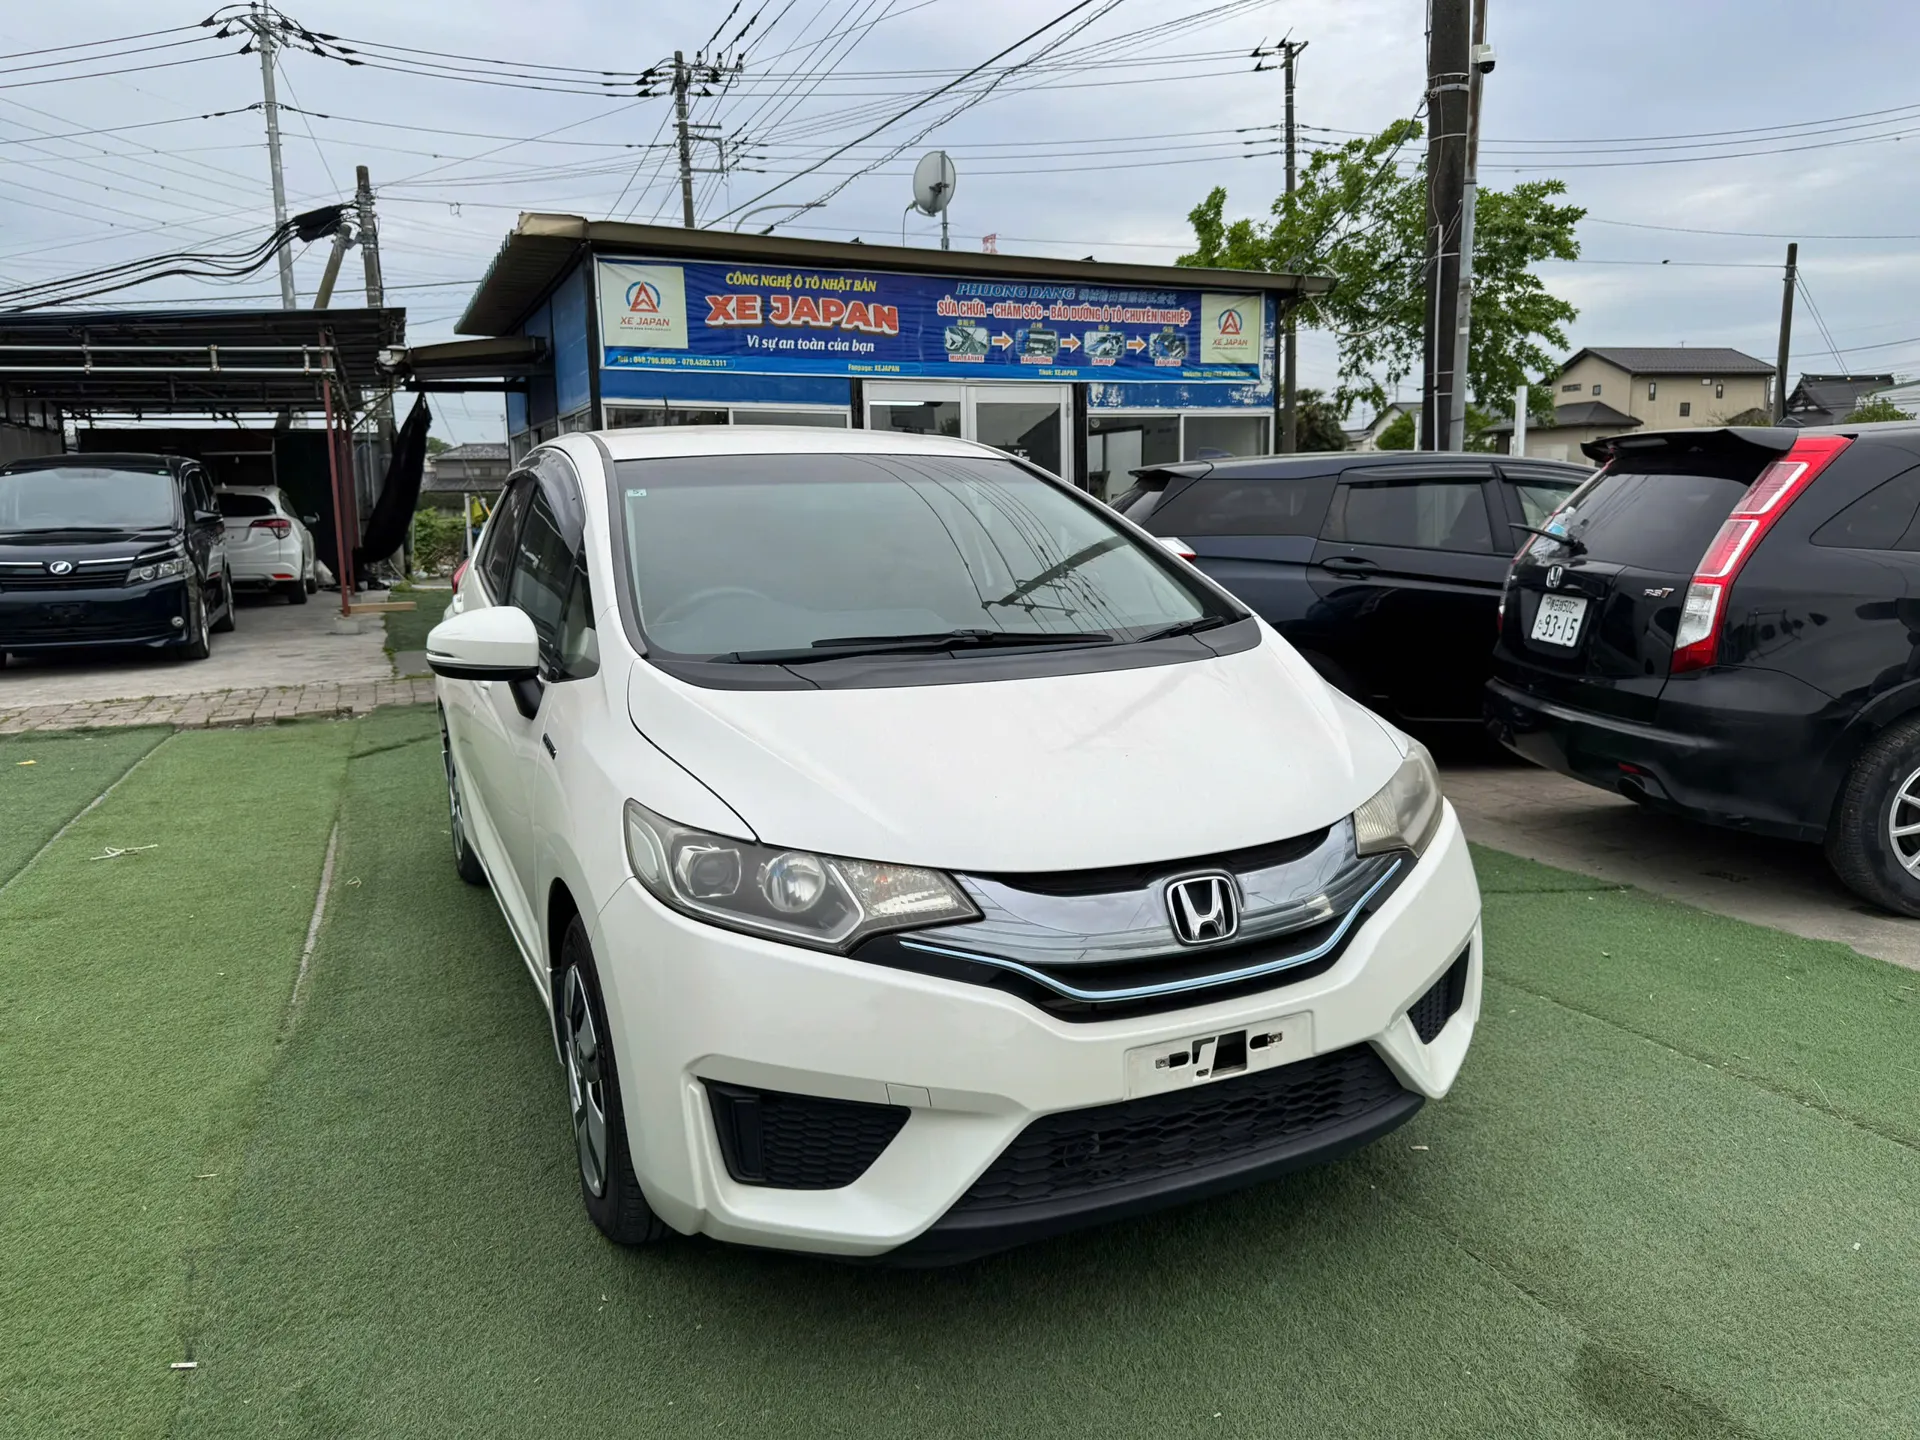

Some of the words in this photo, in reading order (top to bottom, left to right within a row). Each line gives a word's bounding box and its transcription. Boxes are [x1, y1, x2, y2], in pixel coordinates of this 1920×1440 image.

[726, 270, 758, 286] CÔNG
[760, 274, 792, 290] NGHỆ
[794, 274, 803, 289] Ô
[805, 275, 820, 290] TÔ
[821, 276, 852, 294] NHẬT
[853, 278, 877, 293] BẢN
[956, 282, 1027, 298] PHUONG
[1029, 286, 1075, 300] DANG
[620, 317, 634, 325] XE
[636, 317, 670, 327] JAPAN
[705, 294, 763, 327] XE
[769, 294, 899, 336] JAPAN
[937, 295, 958, 316] SỬA
[959, 298, 986, 318] CHỮA
[1123, 306, 1158, 324] CHUYÊN
[1159, 308, 1191, 327] NGHIỆP
[747, 335, 760, 348] Vì
[762, 337, 778, 352] sự
[780, 340, 795, 350] an
[797, 337, 825, 351] toàn
[828, 337, 850, 352] của
[852, 340, 875, 355] bạn
[1212, 338, 1222, 346] XE
[1542, 614, 1578, 641] 93-15
